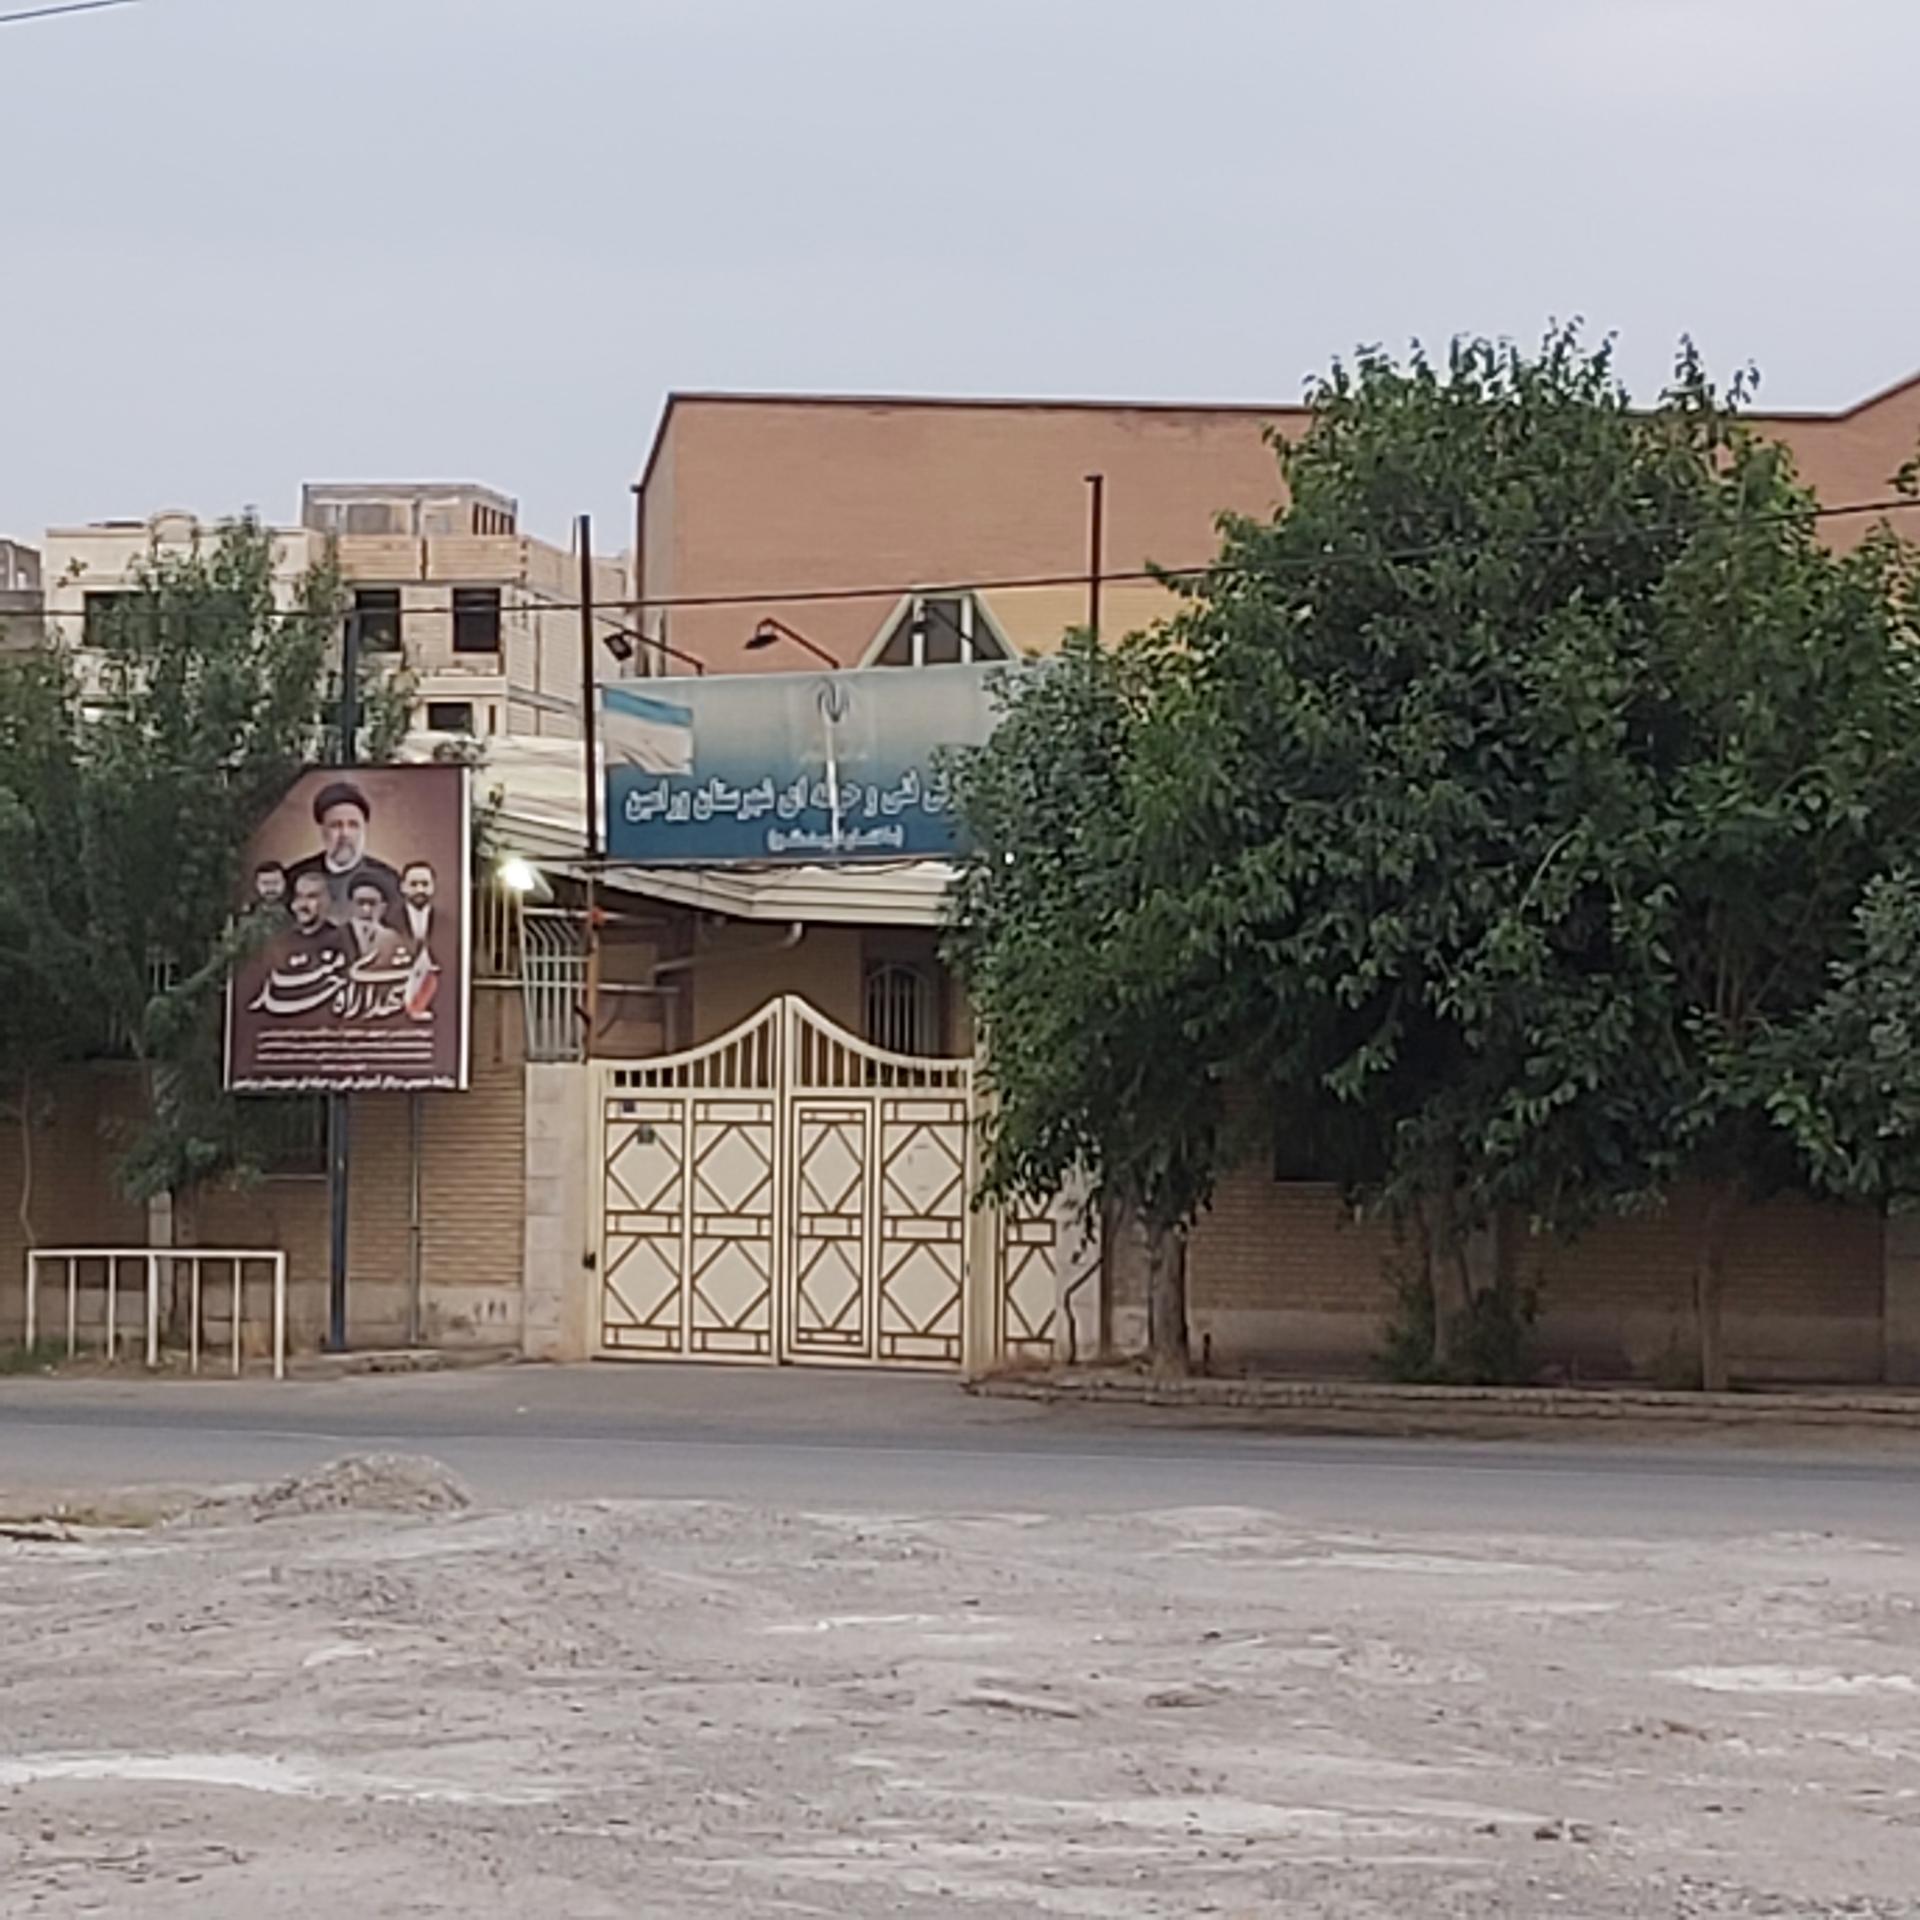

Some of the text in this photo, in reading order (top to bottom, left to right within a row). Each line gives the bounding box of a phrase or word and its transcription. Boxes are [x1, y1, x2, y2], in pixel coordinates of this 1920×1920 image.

[625, 778, 691, 822] ورامین
[692, 776, 775, 821] شهرستان
[810, 782, 862, 817] حره
[863, 785, 878, 817] و
[880, 769, 920, 815] فنی
